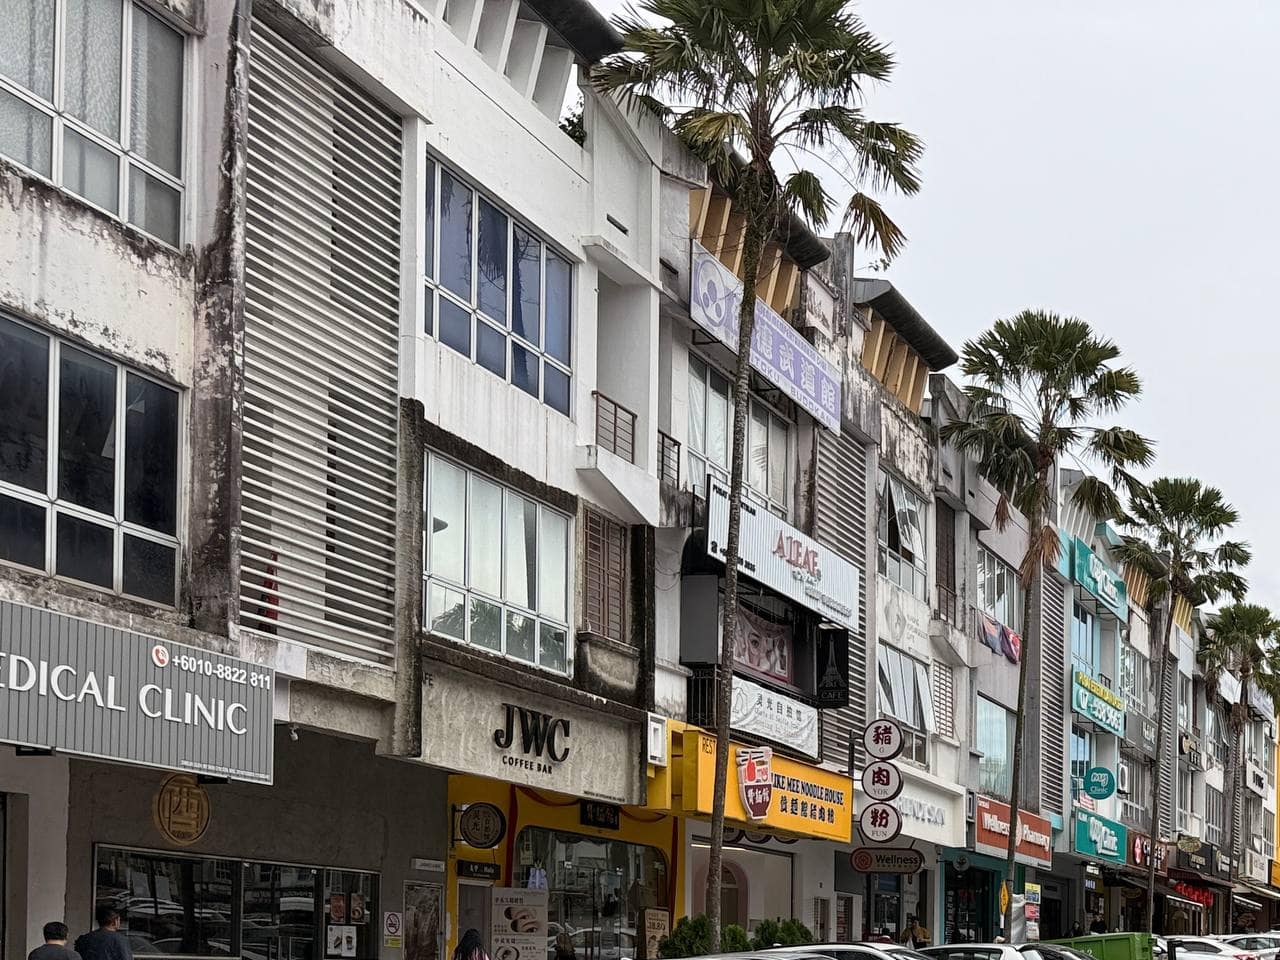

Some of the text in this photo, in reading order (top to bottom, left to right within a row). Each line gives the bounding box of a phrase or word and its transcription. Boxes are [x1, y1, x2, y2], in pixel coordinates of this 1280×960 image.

[172, 654, 271, 690] +6010-8822 811
[0, 651, 248, 735] DICAL CLINIC
[494, 703, 570, 762] JWC
[502, 756, 553, 774] COFFEE BAR
[872, 767, 890, 787] 肉
[787, 778, 801, 795] MEE
[824, 787, 844, 806] HOUSE
[871, 809, 889, 829] 粉
[875, 854, 919, 865] Wellness
